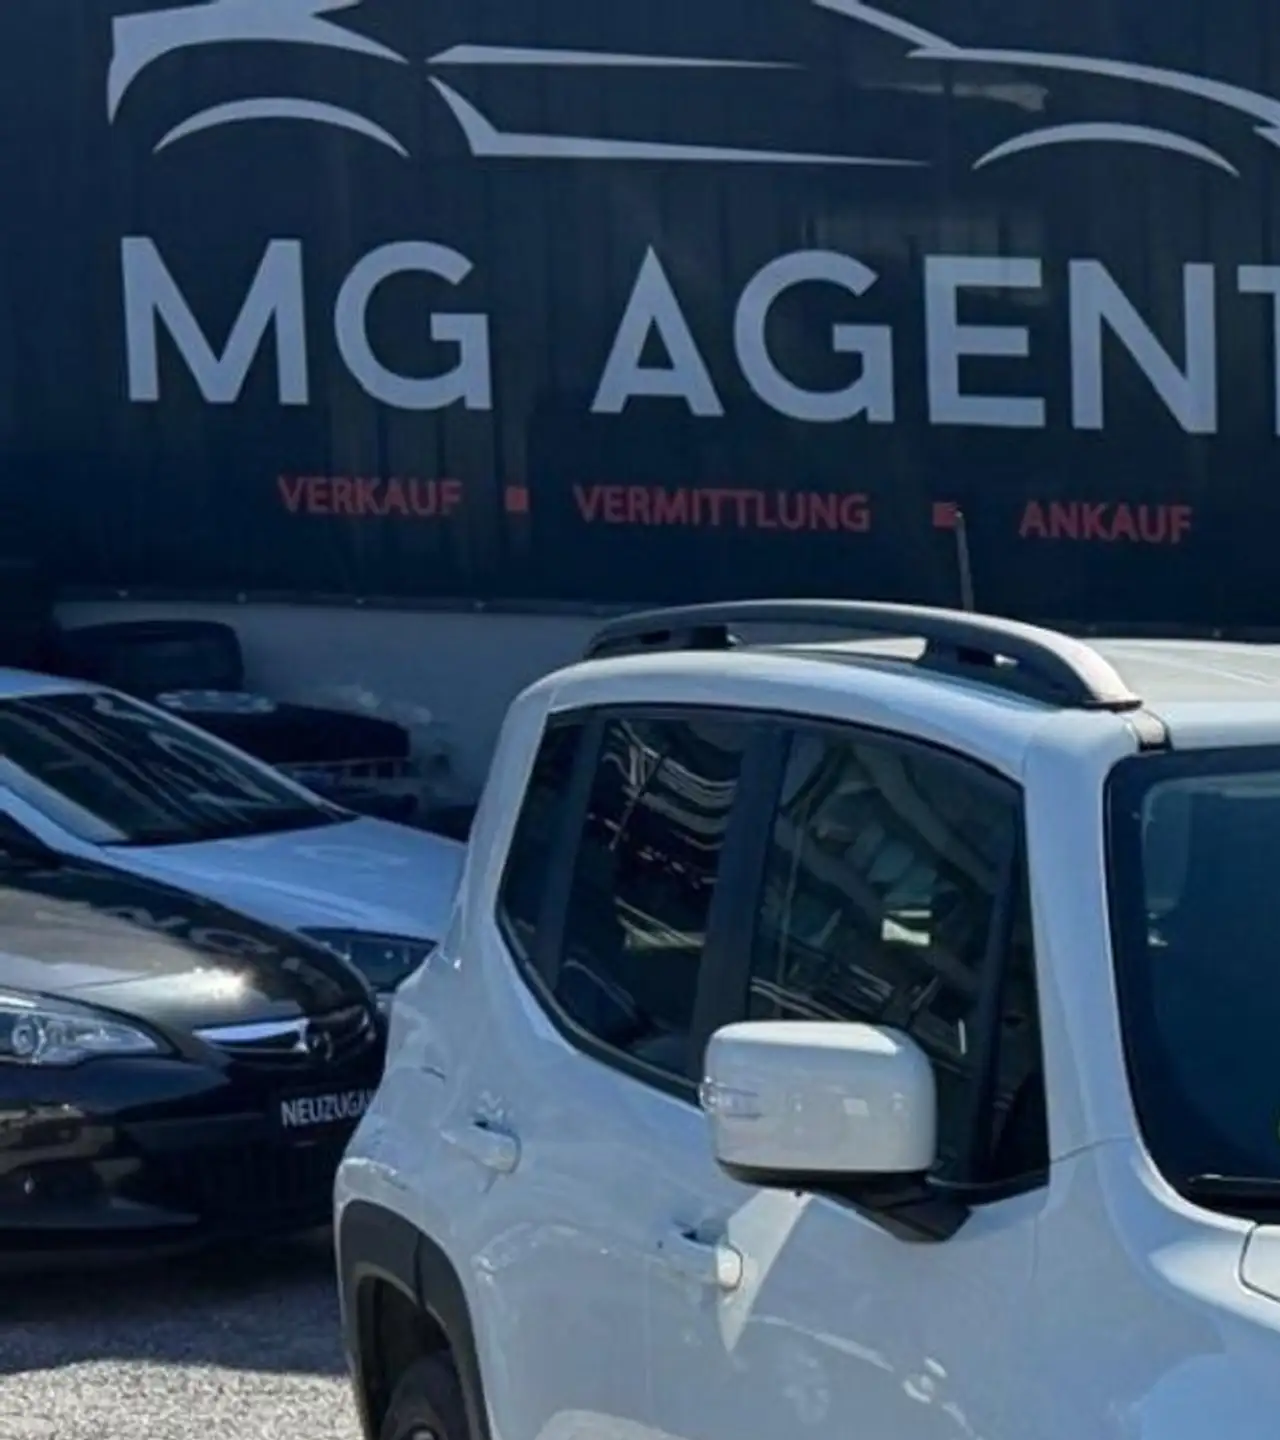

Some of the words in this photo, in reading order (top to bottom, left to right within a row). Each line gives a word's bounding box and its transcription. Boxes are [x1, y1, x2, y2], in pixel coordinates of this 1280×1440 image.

[120, 235, 493, 411] MG
[277, 474, 463, 517] VERKAUF
[572, 483, 871, 533] VERMITTLUNG
[1018, 500, 1193, 545] ANKAUF
